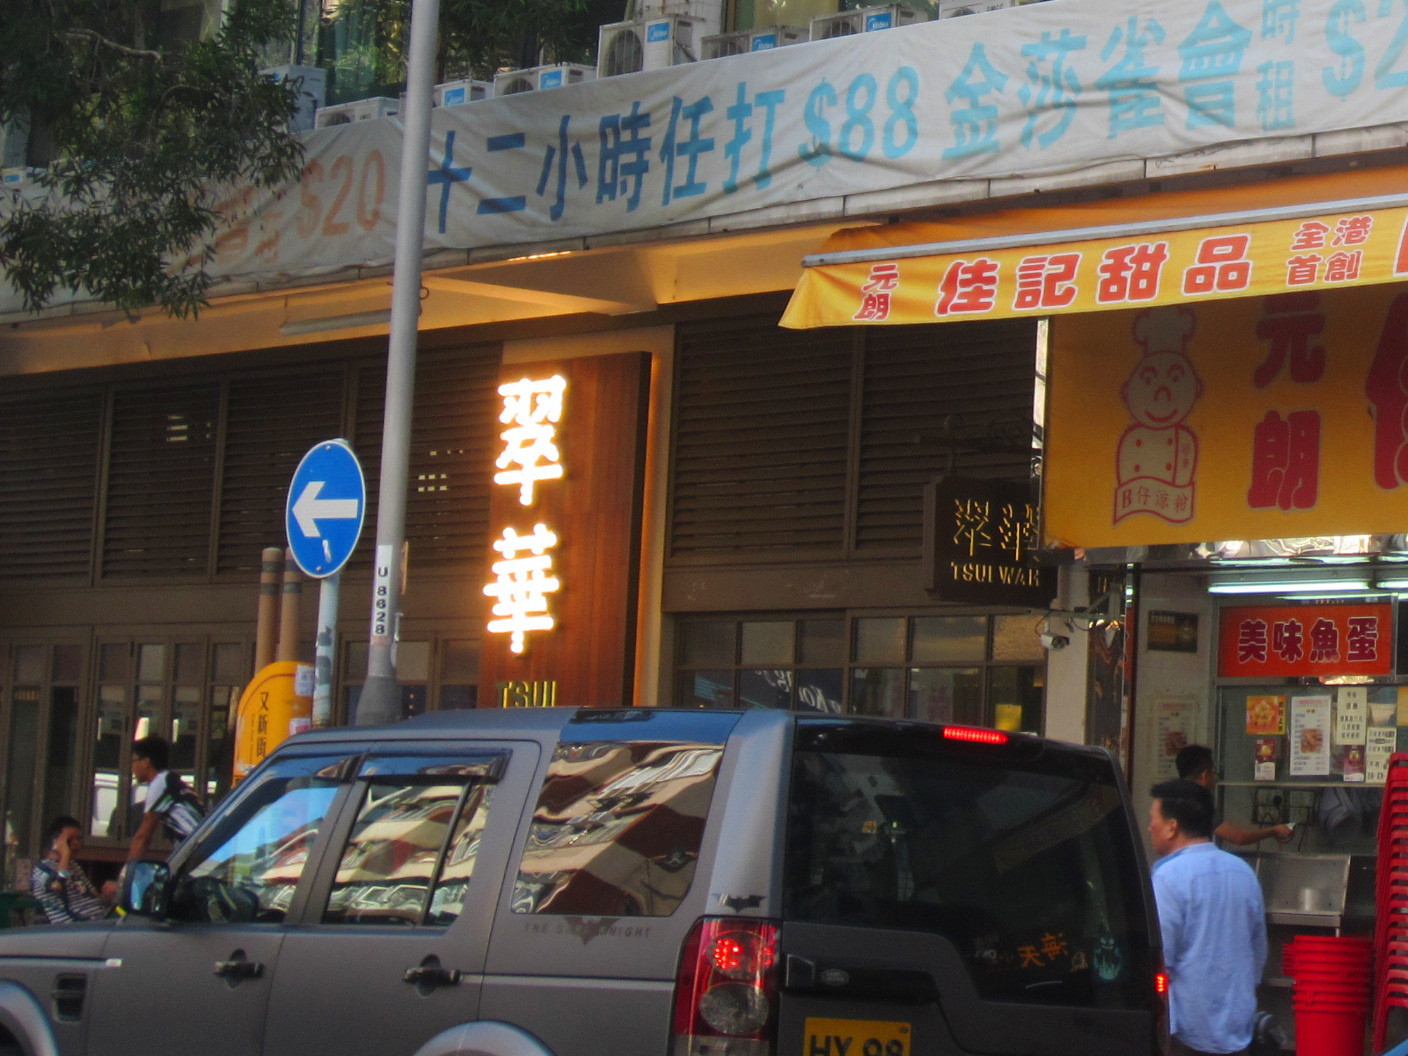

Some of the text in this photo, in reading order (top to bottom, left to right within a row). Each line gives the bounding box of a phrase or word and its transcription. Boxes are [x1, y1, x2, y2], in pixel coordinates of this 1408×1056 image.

[427, 80, 786, 235] 十二小時任打
[802, 66, 920, 169] $88
[941, 0, 1253, 162] 金莎雀會
[296, 149, 386, 239] $20
[1290, 215, 1375, 250] 全港
[854, 262, 900, 322] 元朗
[937, 232, 1253, 317] 佳記甜品
[1285, 248, 1363, 285] 首創
[1247, 296, 1327, 510] 元朗
[486, 375, 567, 654] 翠華
[1122, 486, 1188, 512] B仔涼粉
[950, 561, 1041, 586] TSUI WAH
[1237, 615, 1380, 665] 美味魚蛋
[256, 690, 270, 758] 又新街
[502, 680, 558, 709] TSUI
